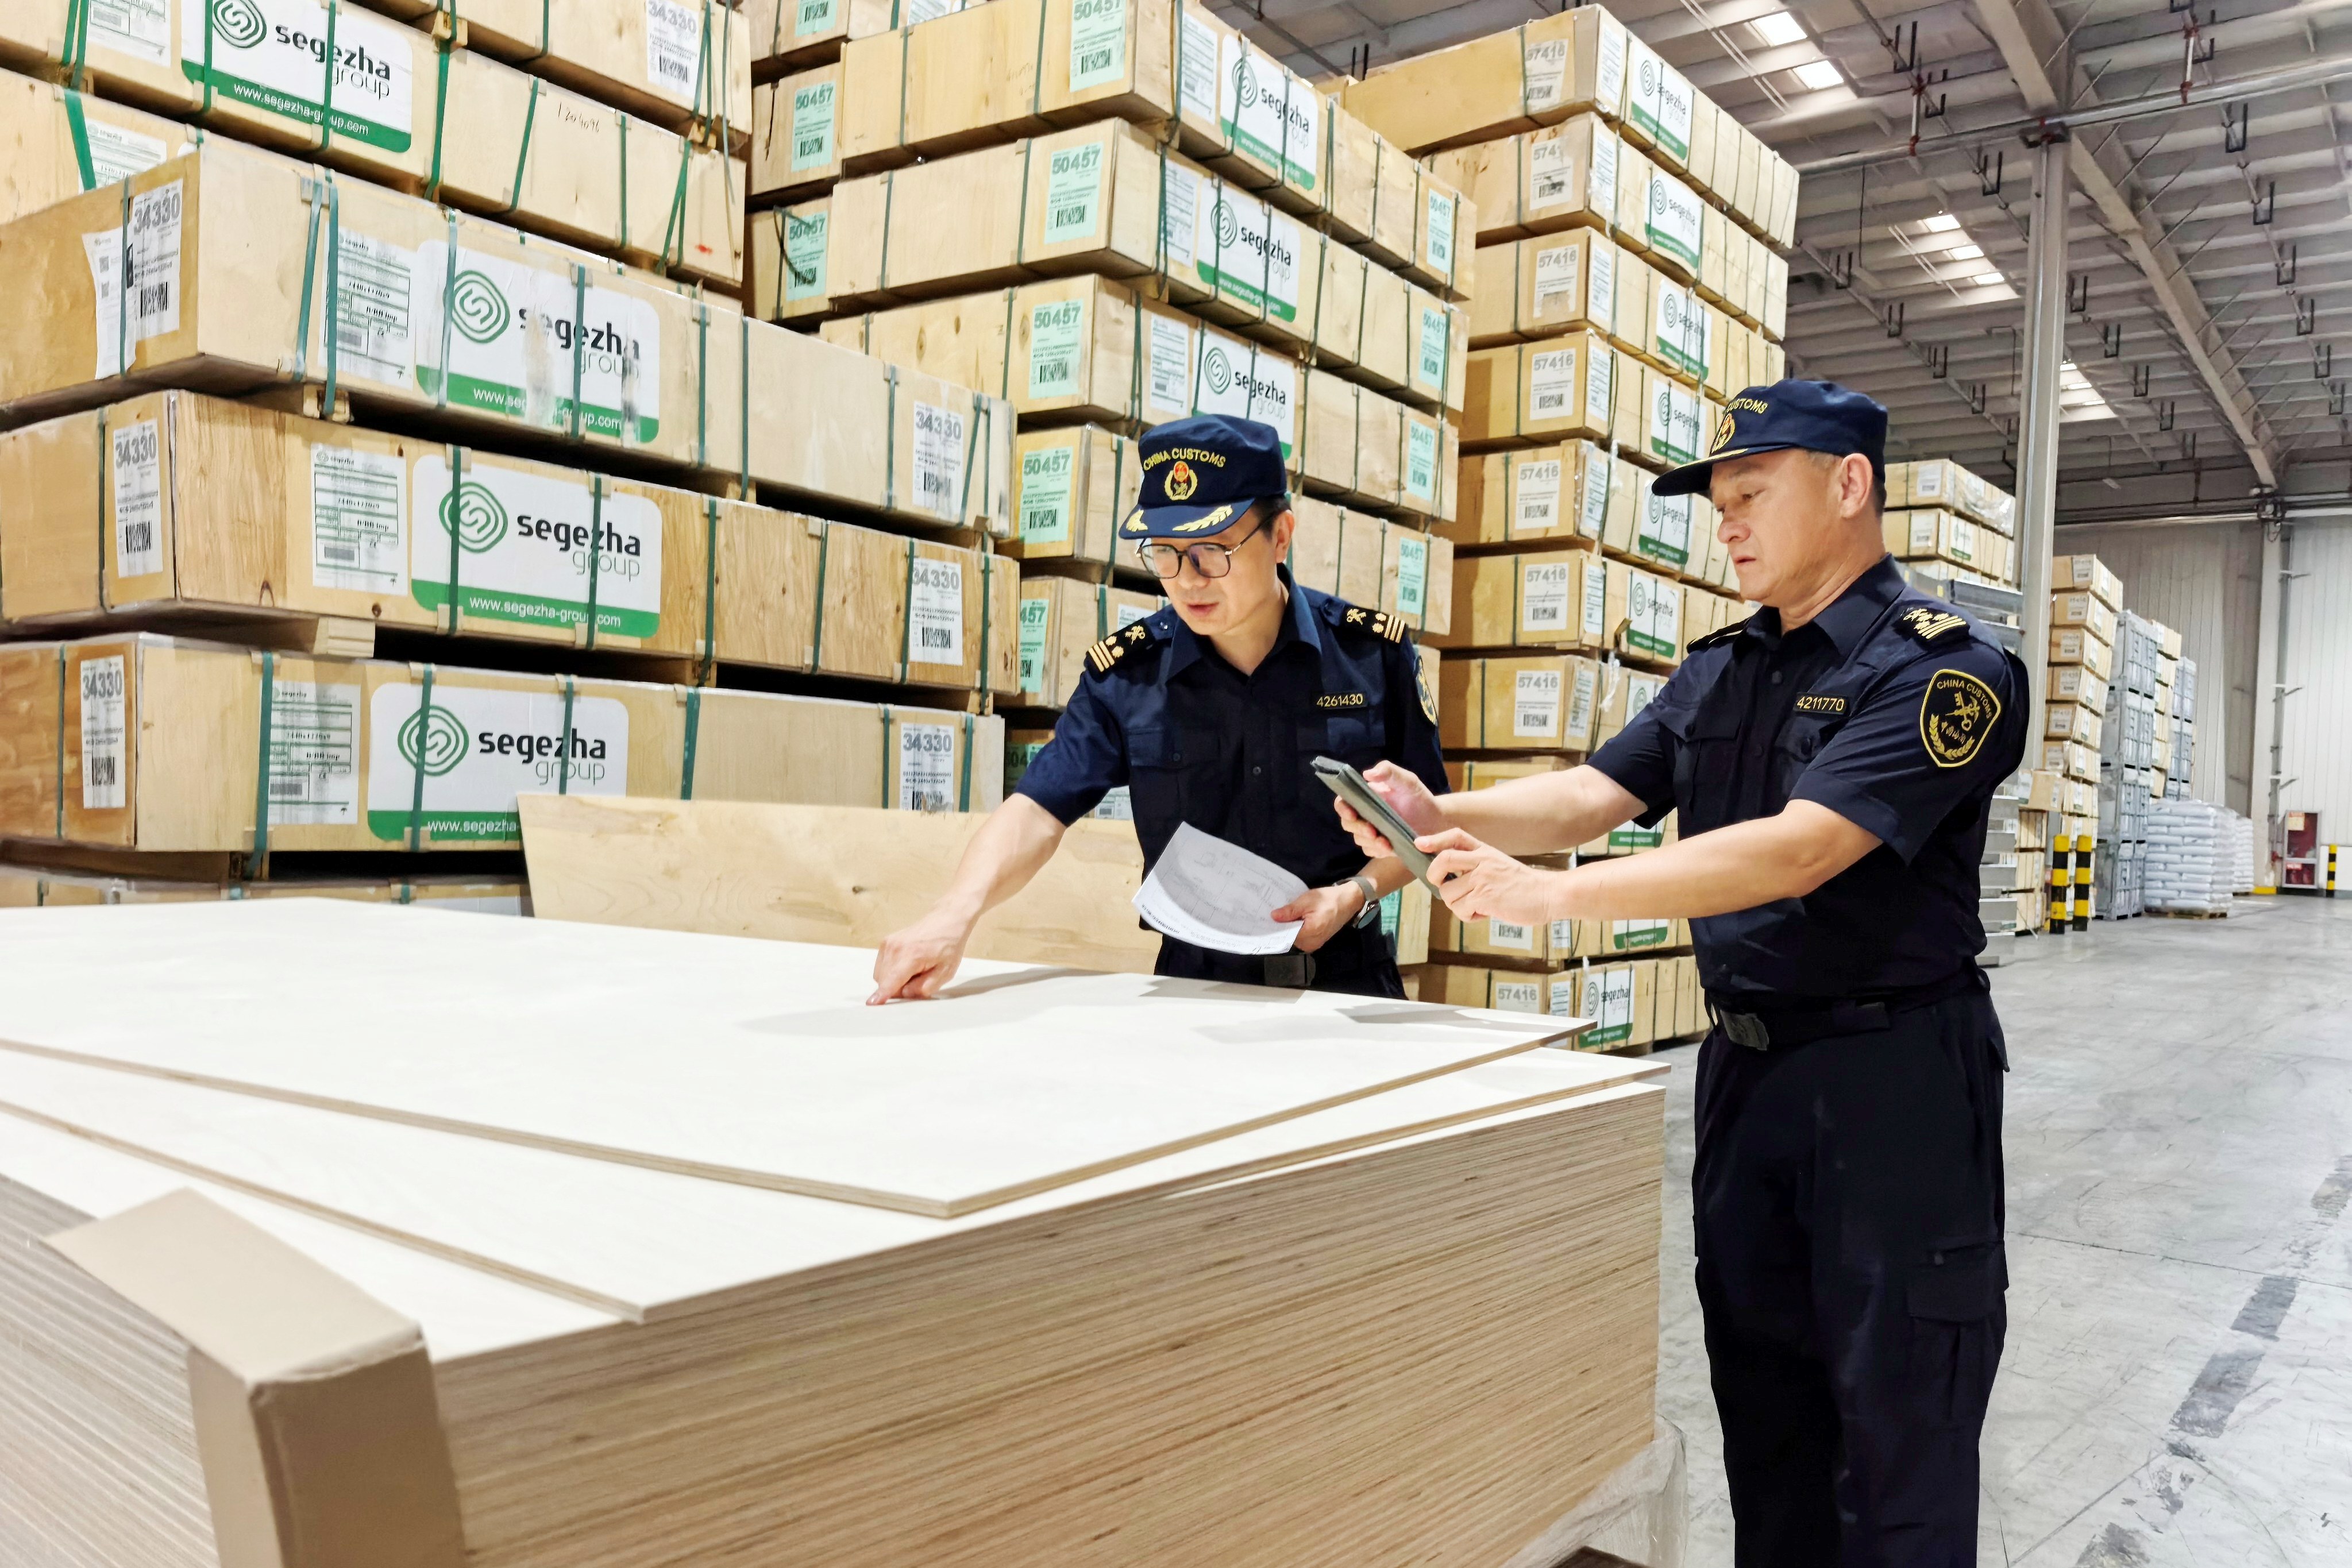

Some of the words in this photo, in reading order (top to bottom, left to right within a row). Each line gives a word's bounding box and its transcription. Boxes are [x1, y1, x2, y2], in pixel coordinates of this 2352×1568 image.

[234, 83, 368, 136] www.segezha-grup.com
[796, 86, 834, 110] 50457
[1052, 149, 1100, 174] 50457
[134, 192, 180, 234] 34330
[1539, 249, 1576, 268] 57416
[1034, 306, 1081, 329] 50457
[519, 308, 639, 360] sgezha
[1533, 353, 1574, 371] 57416
[1235, 371, 1285, 405] segezha
[916, 410, 962, 440] 34330
[115, 432, 157, 469] 34330
[1143, 450, 1170, 471] CHINA
[1172, 447, 1226, 468] CUSTOMS
[1024, 454, 1070, 476] 50457
[1520, 465, 1559, 481] 57416
[912, 567, 959, 590] 34330
[1526, 567, 1566, 582] 57416
[469, 597, 620, 627] www.segezha-groucom
[83, 671, 122, 700] 34330
[1518, 676, 1558, 689] 57416
[1317, 693, 1363, 707] 4261430
[1796, 696, 1844, 711] 4211770
[1937, 679, 1965, 689] CHINA
[1967, 683, 1992, 719] CUSTOMS
[479, 728, 606, 764] segezha
[903, 733, 952, 752] 34330
[1498, 988, 1537, 1001] 57416
